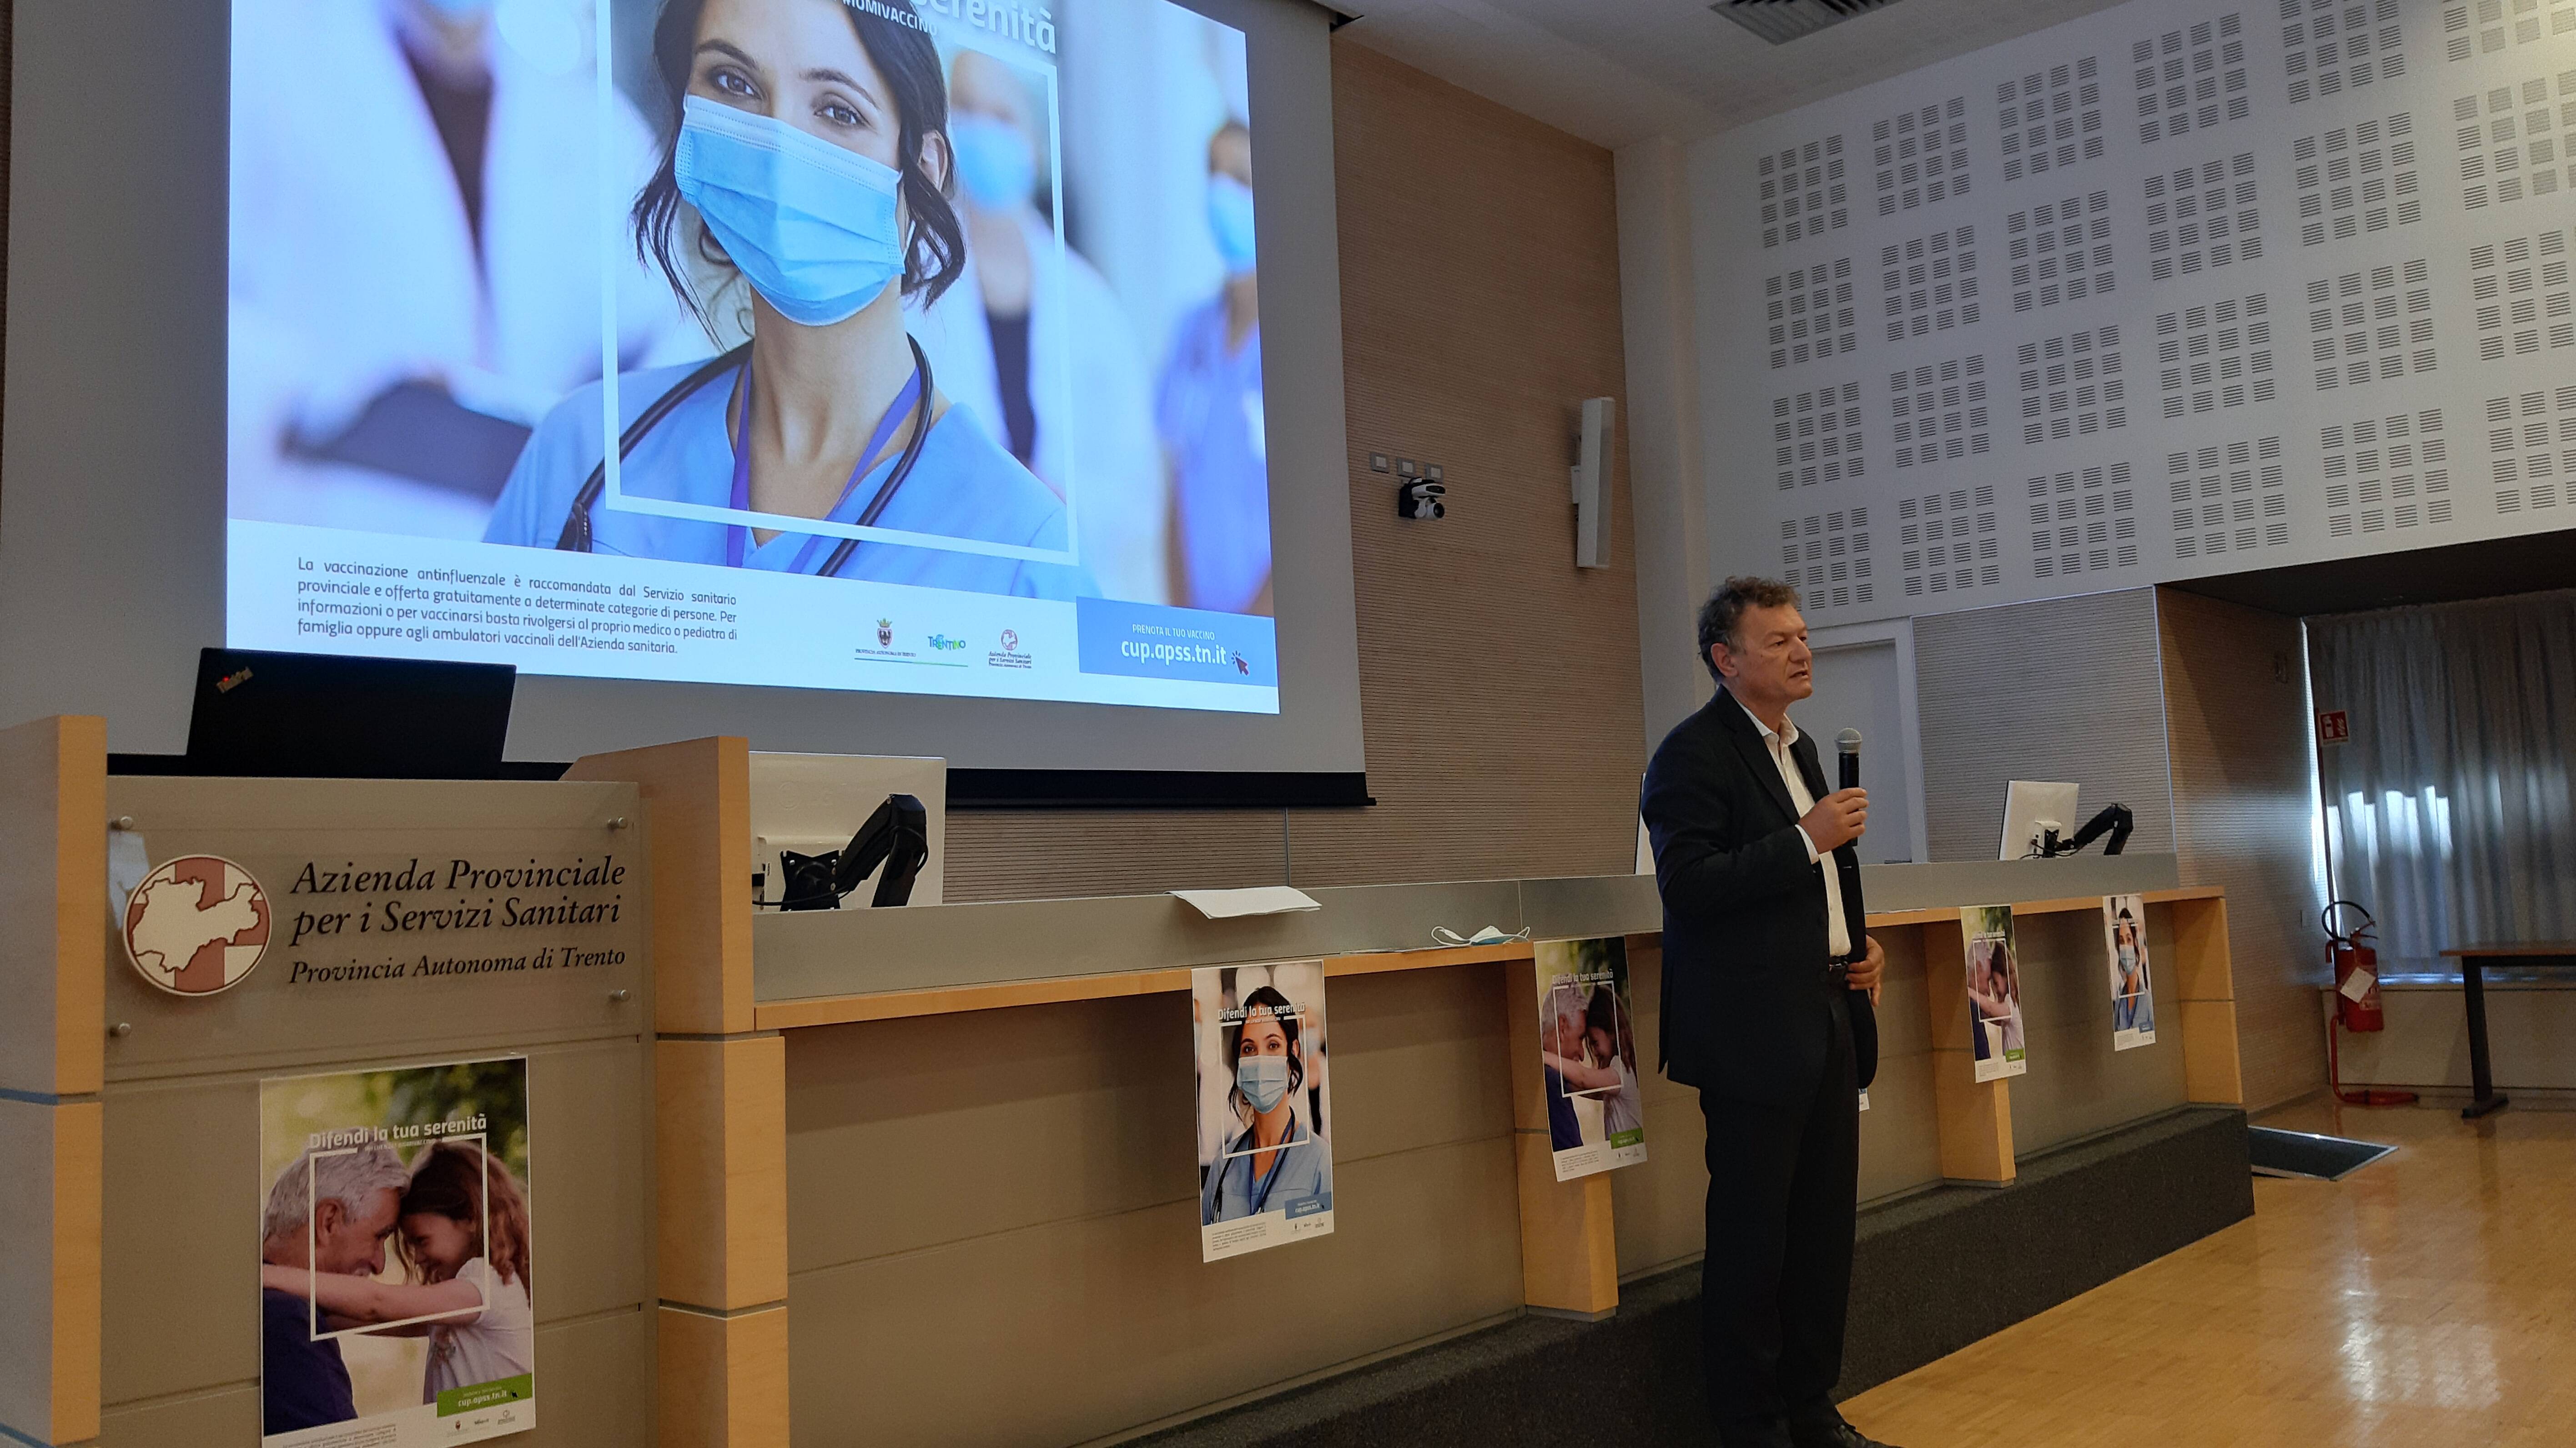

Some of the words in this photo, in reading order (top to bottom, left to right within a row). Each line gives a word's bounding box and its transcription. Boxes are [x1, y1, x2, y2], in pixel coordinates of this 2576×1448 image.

[913, 0, 1056, 54] erenità
[298, 557, 314, 571] La
[324, 561, 408, 578] vaccinazione
[418, 568, 506, 586] antinfluenzale
[514, 575, 521, 587] è
[529, 578, 611, 595] raccomandata
[619, 584, 636, 597] dal
[644, 586, 684, 601] Servizio
[691, 591, 736, 605] sanitario
[298, 579, 370, 595] provinciale
[374, 586, 382, 596] e
[386, 584, 429, 601] offerta
[433, 590, 521, 606] gratuitamente
[524, 598, 532, 607] a
[535, 596, 605, 613] determinate
[608, 603, 658, 618] categorie
[661, 606, 670, 618] di
[674, 608, 717, 622] persone.
[720, 611, 737, 623] Per
[298, 599, 382, 616] informazioni
[386, 608, 394, 618] o
[397, 608, 417, 621] per
[421, 608, 483, 623] vaccinarsi
[486, 611, 519, 626] basta
[523, 615, 575, 630] rivolgersi
[578, 618, 588, 630] al
[592, 621, 631, 635] proprio
[633, 623, 671, 636] medico
[674, 628, 680, 637] o
[684, 626, 725, 639] pediatra
[729, 629, 737, 640] di
[298, 618, 352, 637] famiglia
[357, 626, 402, 639] oppure
[406, 626, 429, 642] agli
[433, 628, 500, 644] ambulatori
[504, 634, 554, 647] vaccinali
[558, 634, 625, 651] dell'Azienda
[628, 639, 678, 654] sanitaria.
[1132, 624, 1163, 636] PRENOTA
[1165, 627, 1171, 636] IL
[1172, 628, 1186, 638] TUO
[1187, 629, 1215, 640] VACCINO
[1121, 641, 1227, 665] cup.apss.tn.it
[290, 859, 435, 894] Azienda
[445, 855, 626, 890] Provinciale
[289, 909, 351, 946] per
[360, 902, 372, 933] i
[381, 899, 493, 932] Servizi
[502, 895, 621, 927] Sanitari
[289, 957, 405, 984] Provincia
[412, 953, 526, 976] Autonoma
[533, 948, 553, 969] di
[560, 946, 626, 967] Trento
[1218, 1006, 1247, 1021] Difendi
[1249, 1006, 1257, 1017] la
[1259, 1005, 1272, 1016] tua
[1274, 1002, 1305, 1015] serenità
[309, 1128, 368, 1149] Difendi
[374, 1126, 388, 1142] la
[392, 1124, 419, 1139] tua
[424, 1113, 487, 1136] serenità
